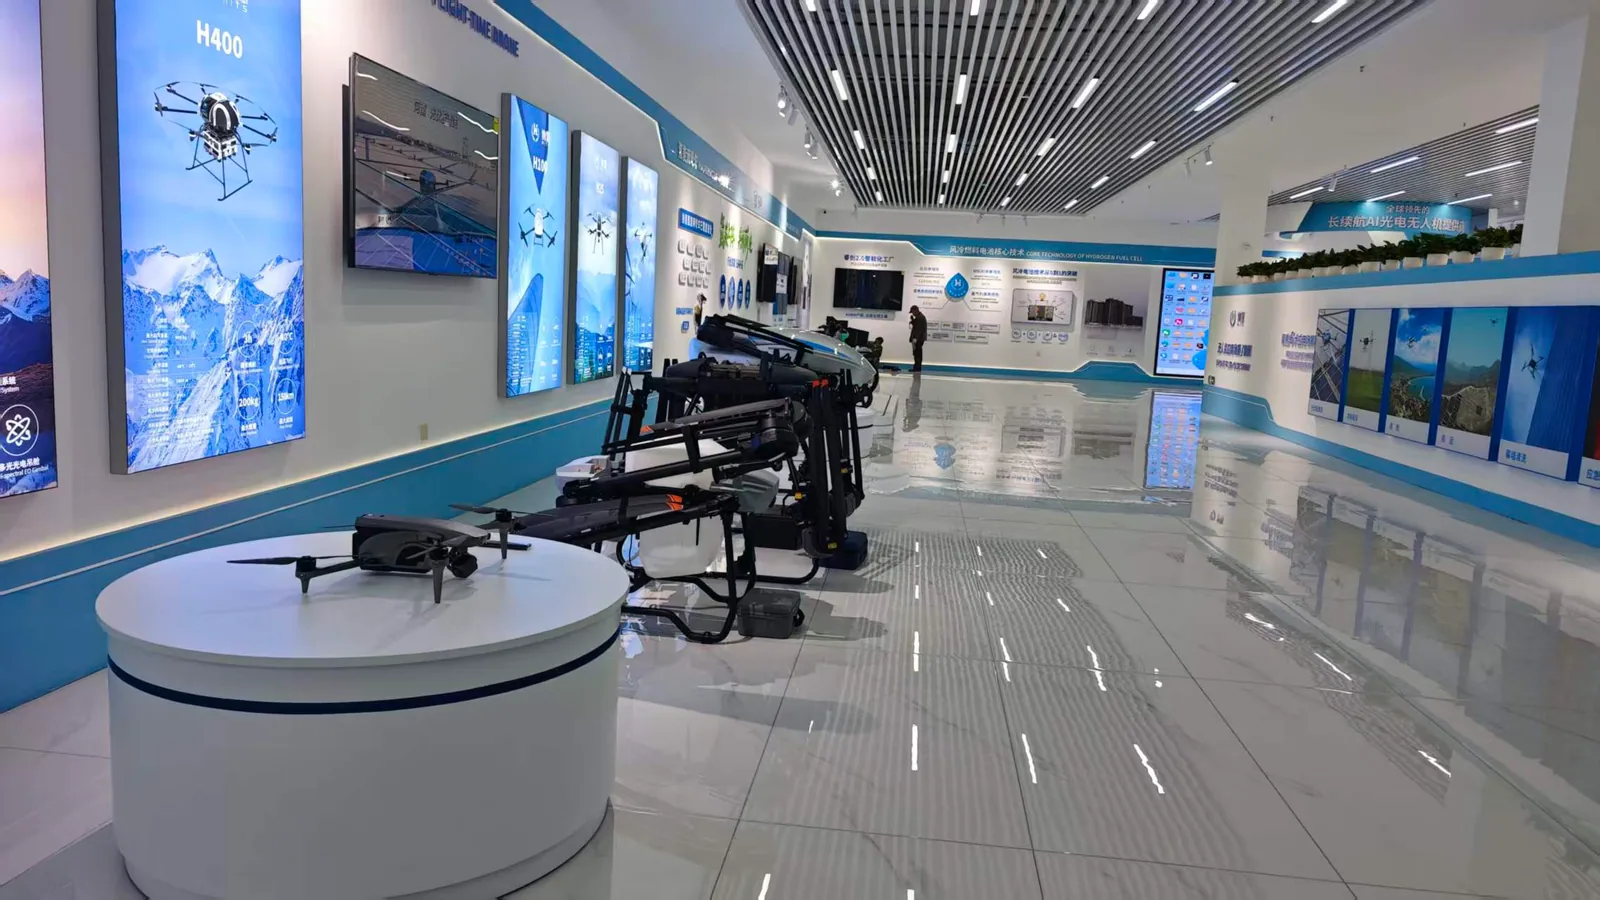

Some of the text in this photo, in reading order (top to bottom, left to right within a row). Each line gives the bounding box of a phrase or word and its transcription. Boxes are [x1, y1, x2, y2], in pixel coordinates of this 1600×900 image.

[196, 20, 243, 59] H400
[491, 26, 519, 57] DRONE
[1386, 204, 1430, 215] 全球领先的
[1041, 251, 1077, 259] TECHNOLOGY
[239, 397, 259, 407] 200kg
